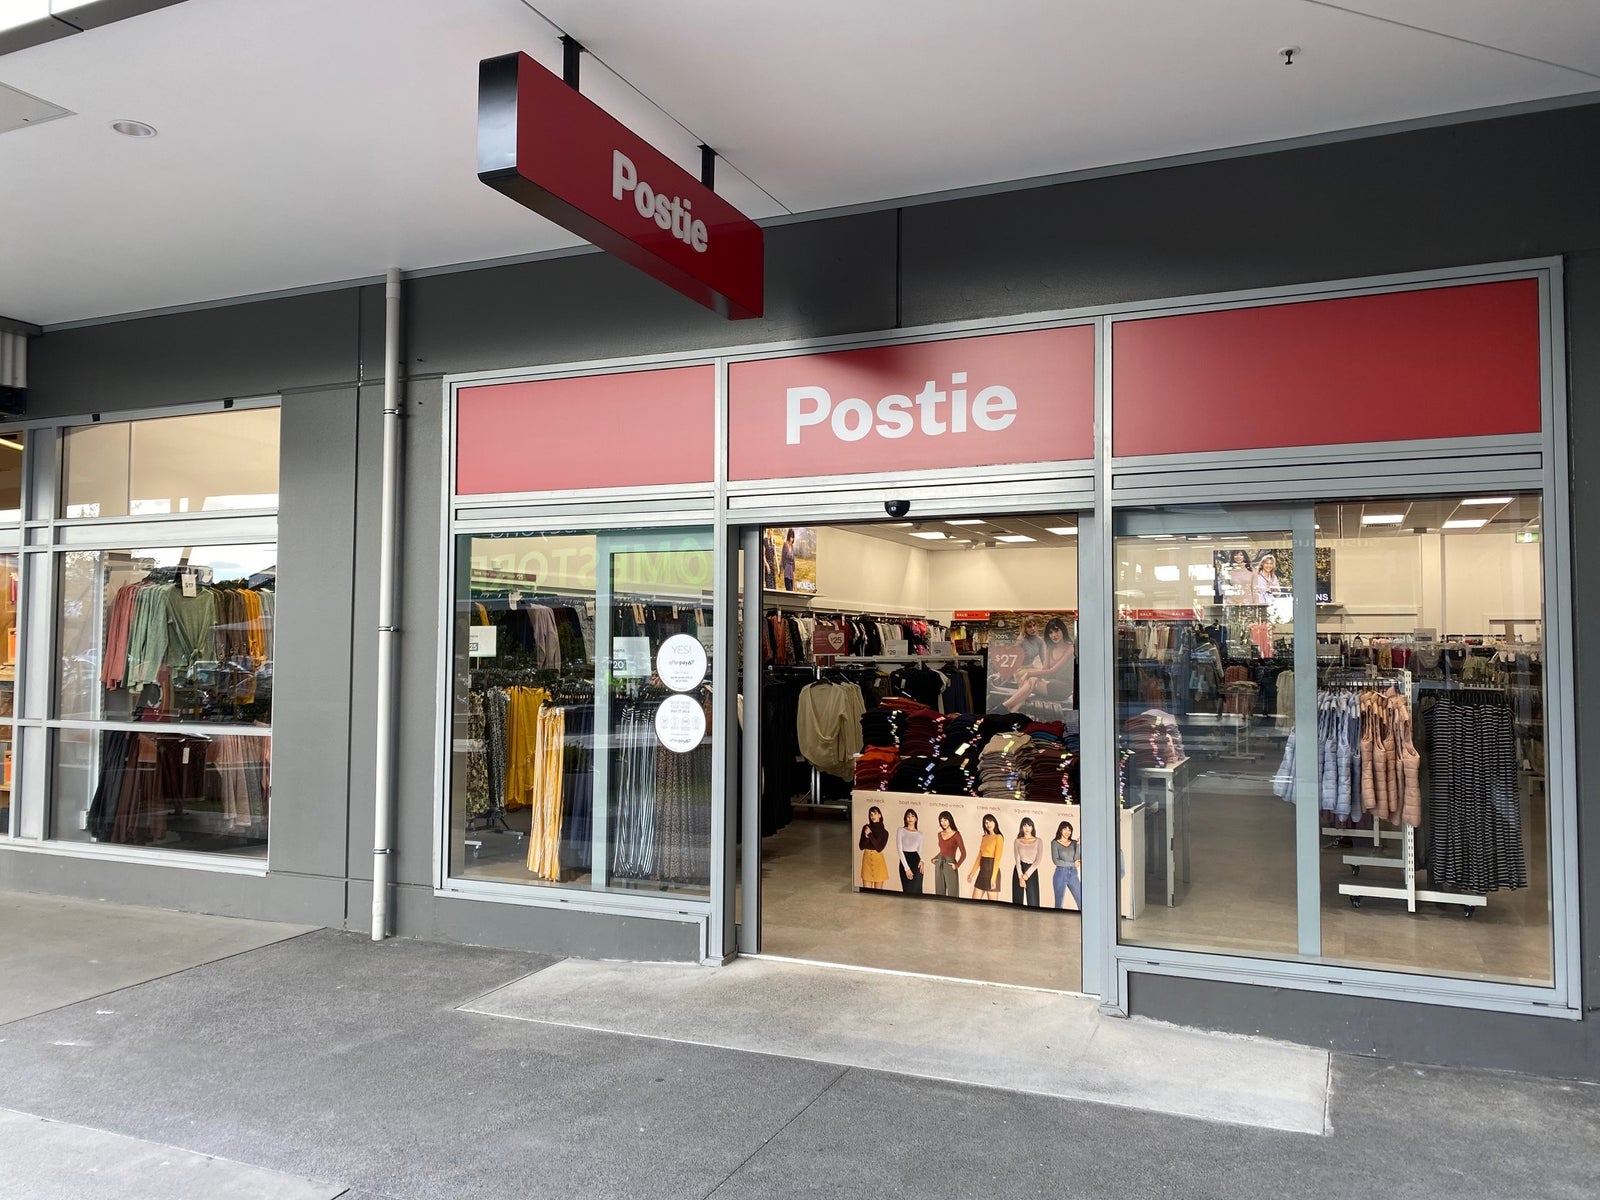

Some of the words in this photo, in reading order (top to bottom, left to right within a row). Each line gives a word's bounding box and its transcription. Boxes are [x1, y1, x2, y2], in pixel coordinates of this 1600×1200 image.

[612, 149, 708, 253] Postie
[786, 371, 1018, 446] Postie
[995, 654, 1018, 668] $27
